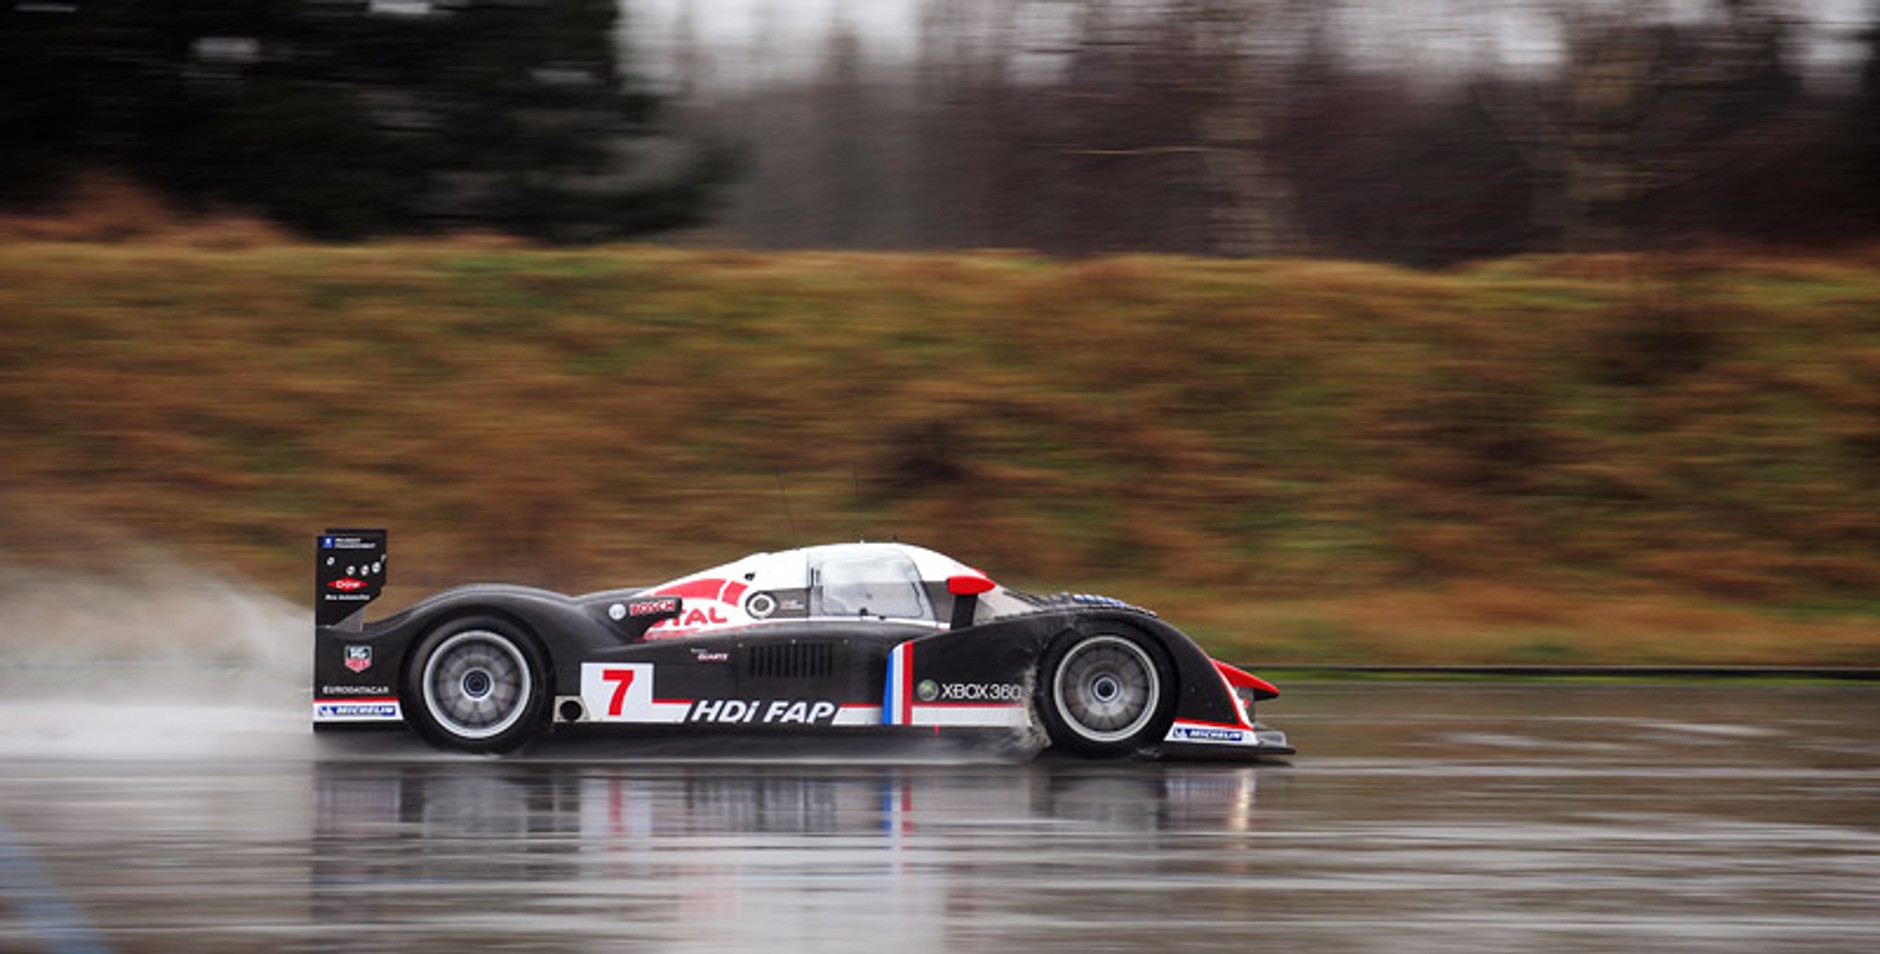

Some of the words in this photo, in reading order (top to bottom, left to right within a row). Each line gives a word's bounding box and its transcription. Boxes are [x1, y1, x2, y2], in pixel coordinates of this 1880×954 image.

[602, 669, 635, 716] 7
[941, 683, 989, 699] XBOX
[763, 701, 834, 724] FAP
